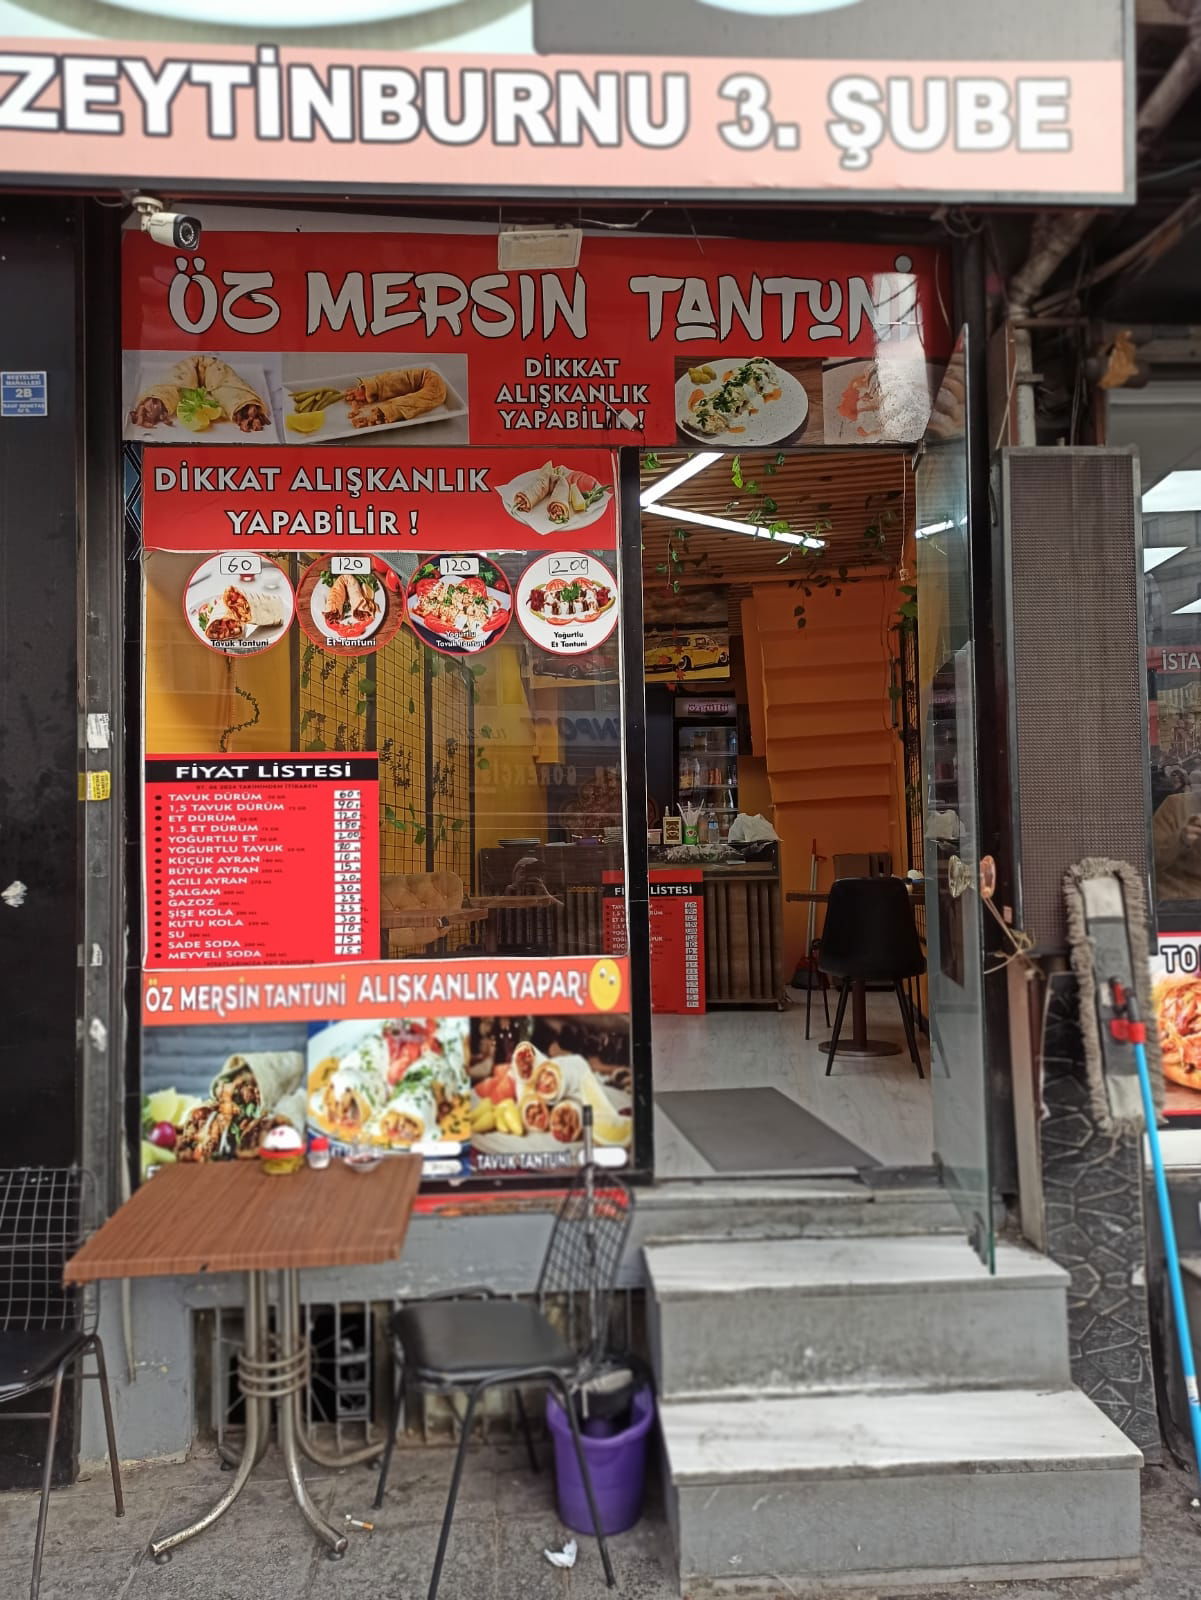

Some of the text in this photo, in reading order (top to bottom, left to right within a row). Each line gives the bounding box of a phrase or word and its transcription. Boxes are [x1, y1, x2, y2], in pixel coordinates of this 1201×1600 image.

[0, 44, 1073, 170] ZEYTİNBURNU 3. ŞUBE
[168, 256, 281, 335] ÖZ
[525, 354, 621, 378] DİKKAT
[495, 383, 650, 409] ALIŞKANLIK
[153, 461, 491, 499] DİKKAT ALIŞKANLIK
[225, 504, 419, 536] YAPABİLİR !
[227, 557, 252, 573] 60
[338, 558, 363, 571] 120
[445, 559, 471, 573] 120
[551, 559, 588, 574] 200
[554, 631, 584, 640] Yoğurtlu
[211, 638, 269, 647] Tavuk Tantuni
[339, 638, 376, 647] Tantuni
[561, 640, 588, 648] Tantuni
[175, 762, 351, 779] FİYAT LİSTESİ
[168, 793, 210, 801] TAVUK
[214, 791, 262, 801] DÜRÜM
[191, 803, 232, 812] TAVUK
[236, 801, 284, 811] DÜRÜM
[188, 813, 236, 822] DÜRÜM
[210, 823, 259, 832] DÜRÜM
[168, 834, 238, 843] YOĞURTLU
[242, 834, 258, 842] ET
[168, 844, 238, 854] YOĞURTLU
[241, 845, 283, 853] TAVUK
[168, 855, 260, 866] KÜÇÜK AYRAN
[168, 865, 213, 874] BÜYÜK
[216, 865, 259, 873] AYRAN
[168, 877, 201, 885] ACILI
[204, 877, 247, 885] AYRAN
[168, 888, 221, 898] ŞALGAM
[650, 885, 693, 895] LİSTESİ
[168, 898, 215, 907] GAZOZ
[168, 908, 194, 919] ŞİŞE
[198, 908, 233, 916] KOLA
[168, 920, 204, 928] KUTU
[208, 919, 244, 927] KOLA
[168, 930, 185, 938] SU
[168, 941, 201, 949] SADE
[205, 940, 241, 948] SODA
[168, 950, 222, 960] MEYVELİ
[226, 950, 262, 959] SODA
[146, 978, 173, 1012] ÖZ
[180, 976, 259, 1017] MERSİN
[264, 974, 346, 1007] TANTUNİ
[358, 973, 499, 1008] ALIŞKANLIK
